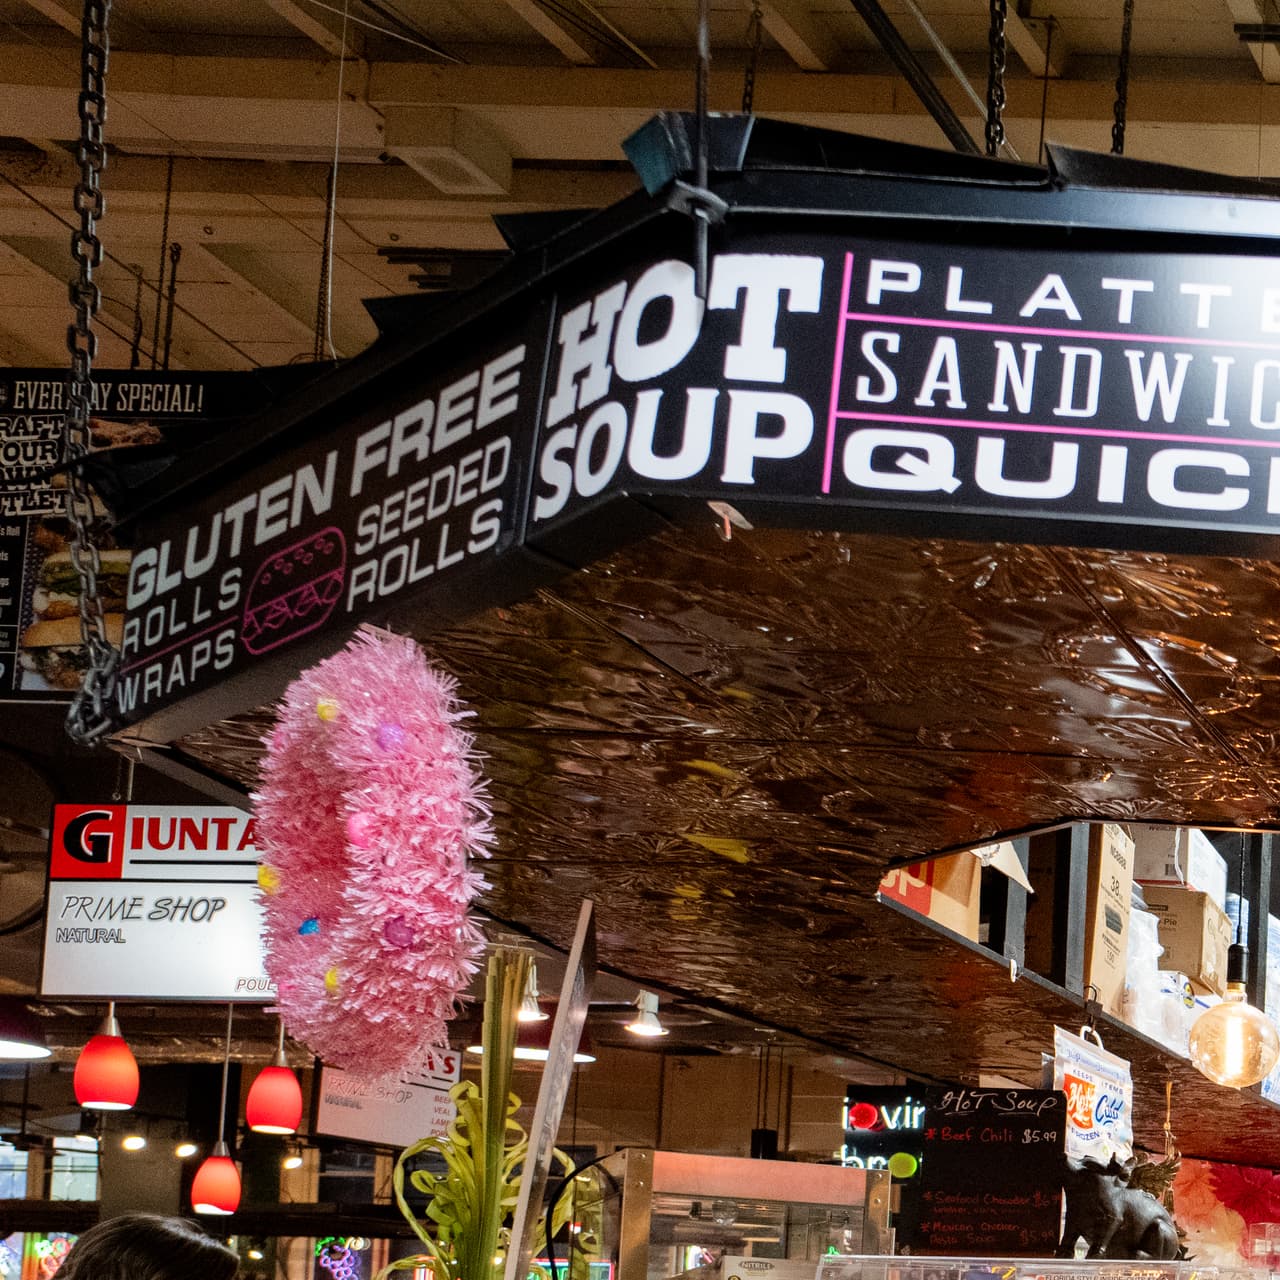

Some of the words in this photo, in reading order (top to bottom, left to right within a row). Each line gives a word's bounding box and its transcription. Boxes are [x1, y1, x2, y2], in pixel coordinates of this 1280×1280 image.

[547, 254, 824, 424] HOT
[116, 383, 204, 413] SPECIAL!
[127, 451, 338, 611] GLUTEN
[350, 344, 526, 495] FREE
[355, 435, 511, 555] SEEDED
[536, 388, 814, 522] SOUP
[347, 497, 502, 611] ROLLS
[121, 565, 243, 660] ROLLS
[116, 629, 235, 715] WRAPS
[56, 927, 126, 944] NATURAL
[59, 896, 143, 921] PRIME
[148, 897, 227, 922] SHOP
